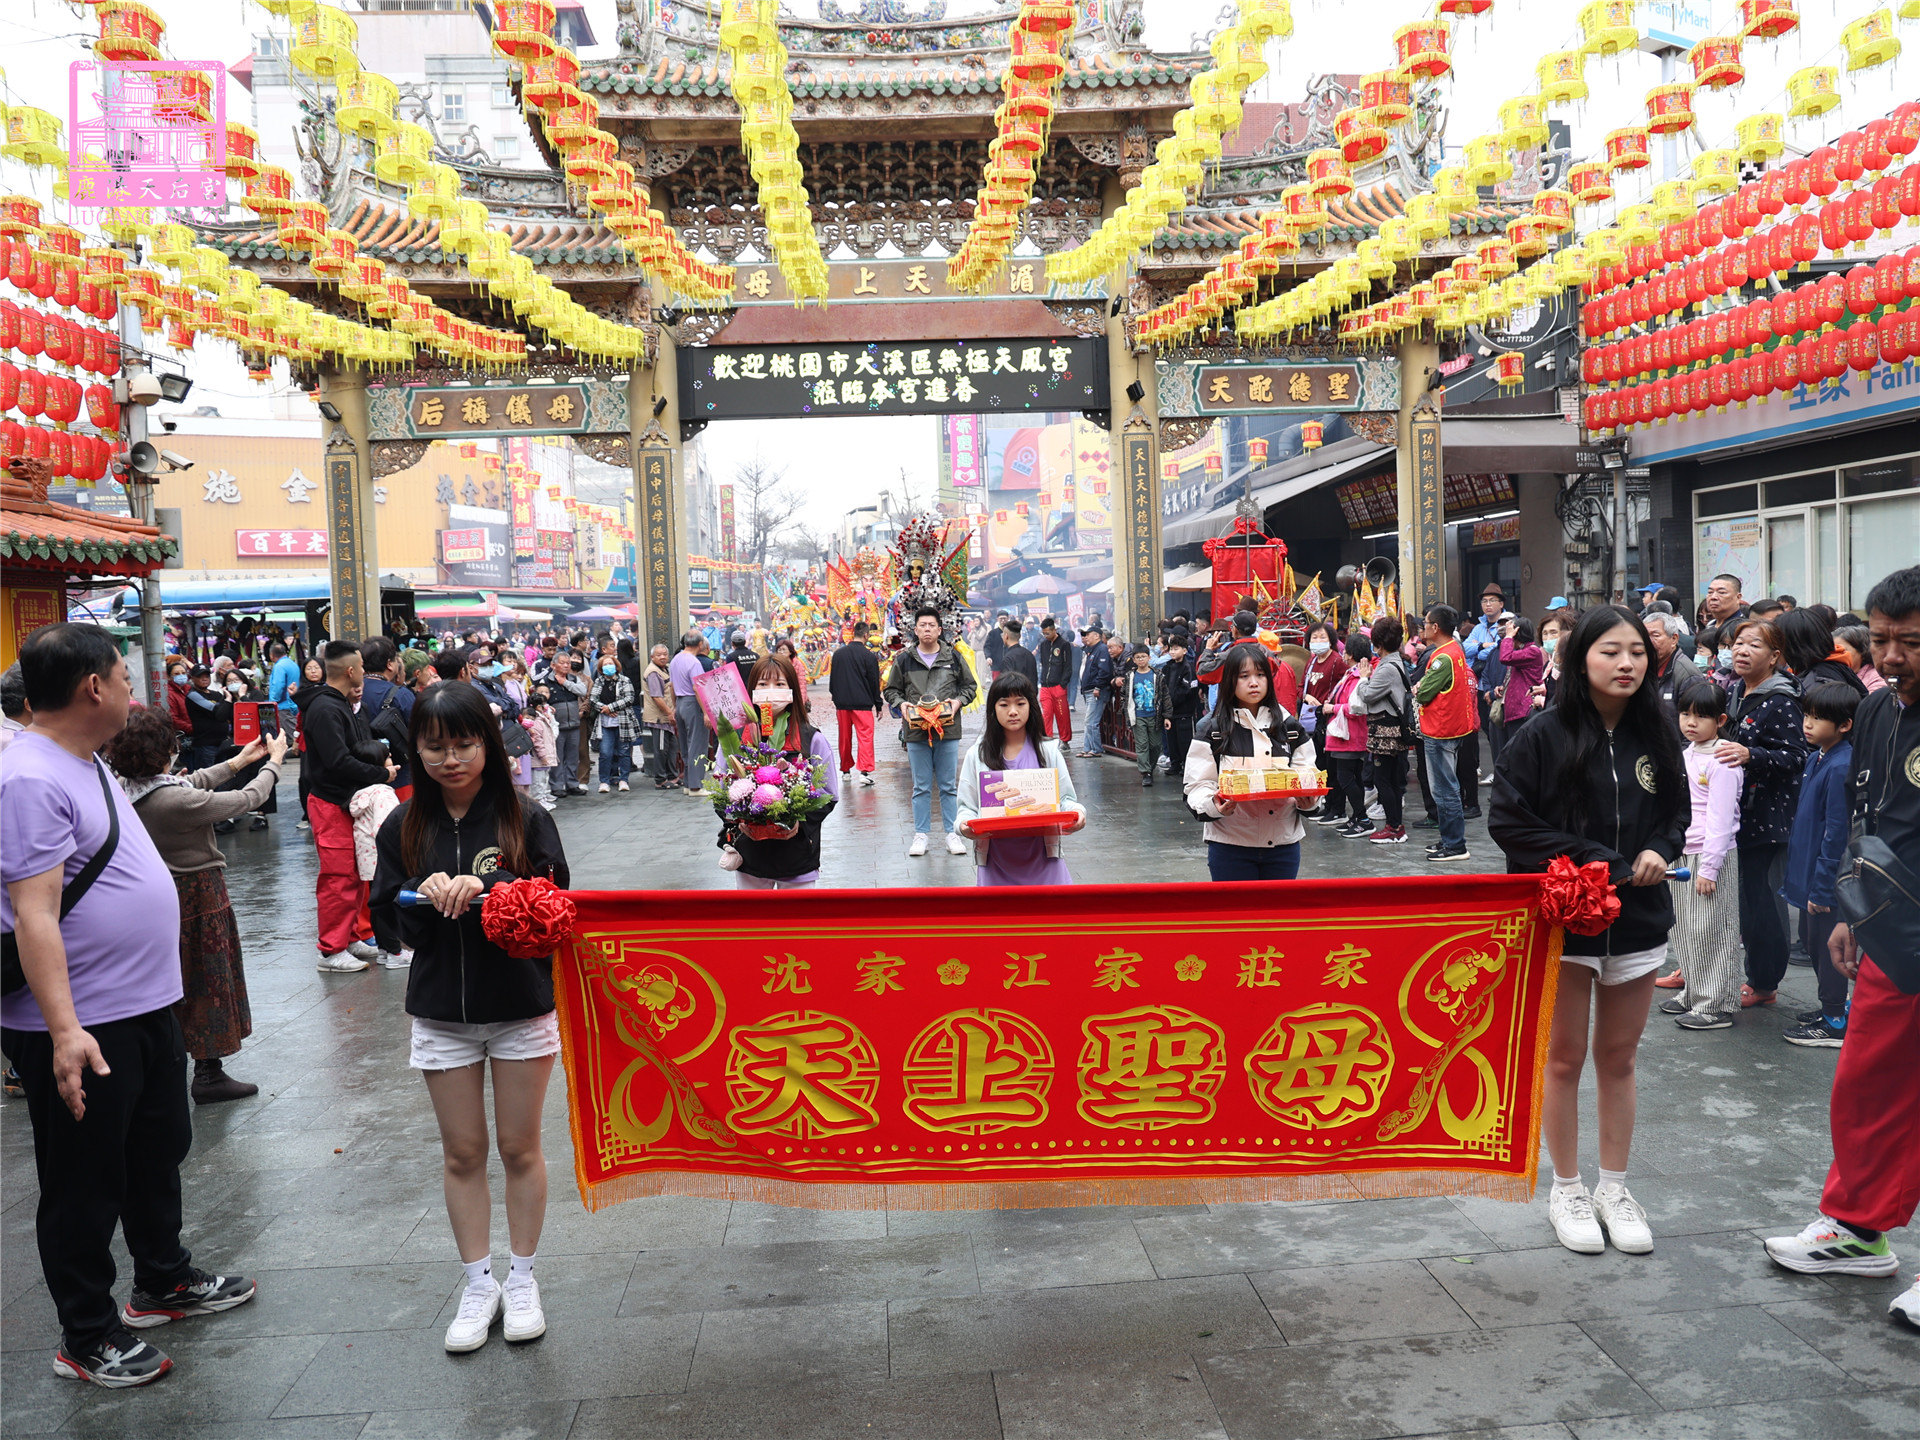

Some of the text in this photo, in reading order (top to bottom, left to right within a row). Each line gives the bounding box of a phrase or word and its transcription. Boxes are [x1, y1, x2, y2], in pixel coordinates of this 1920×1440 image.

[1649, 1, 1709, 30] FamlyMart
[813, 377, 979, 405] 蒞臨本宮進香
[249, 531, 328, 553] 百年老
[762, 943, 1372, 995] 沈家 江家 莊家
[727, 1007, 1395, 1132] 天上聖母
